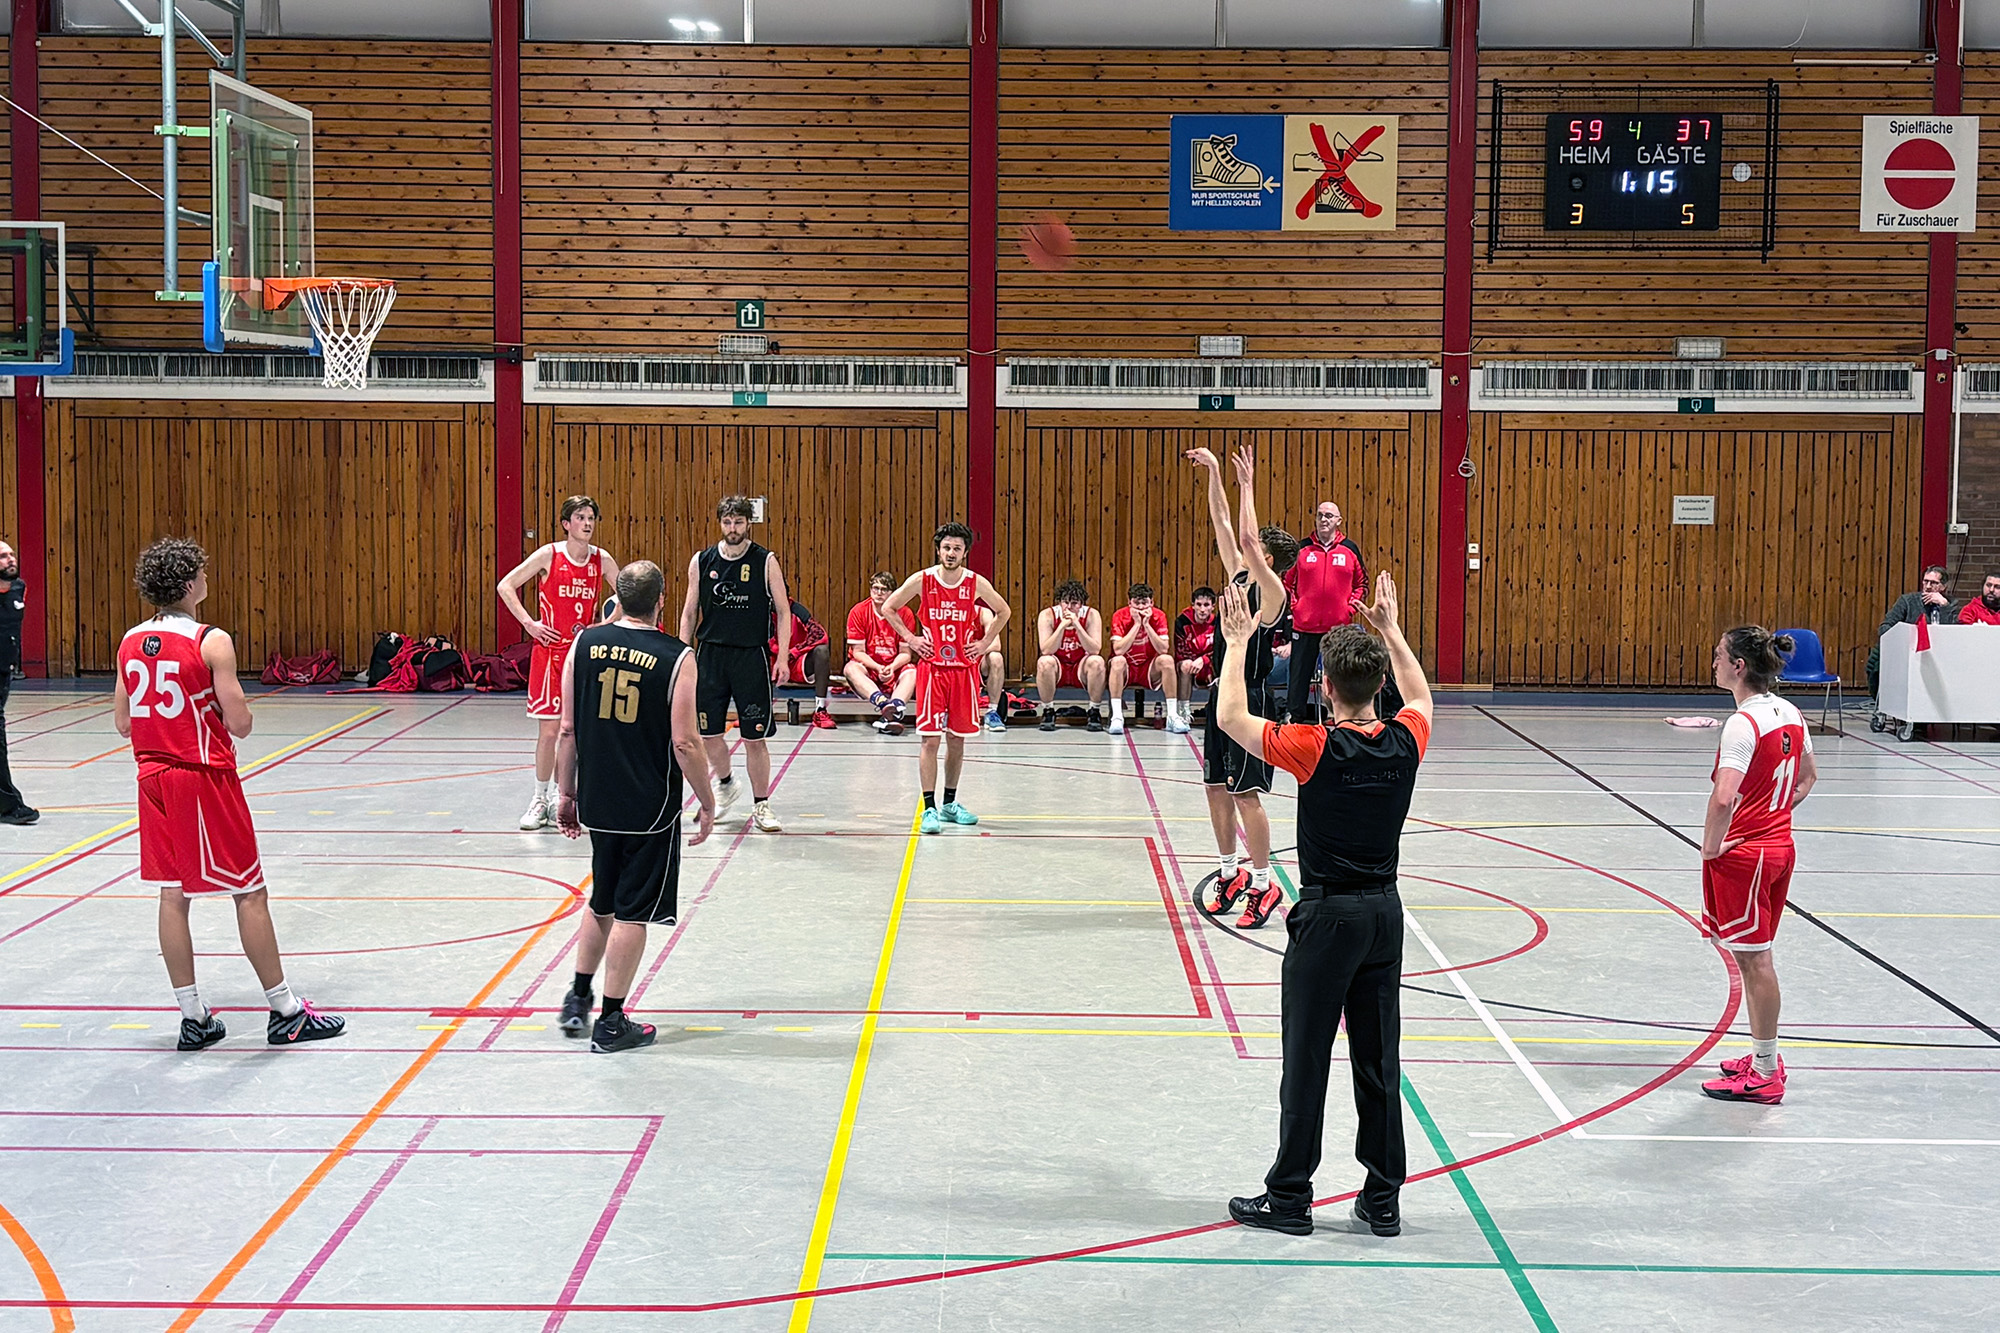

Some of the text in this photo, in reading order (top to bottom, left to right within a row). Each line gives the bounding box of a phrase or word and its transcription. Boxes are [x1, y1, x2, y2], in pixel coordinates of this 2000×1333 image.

[1568, 119, 1604, 141] 59
[1628, 120, 1642, 141] 4
[1676, 119, 1711, 141] 37
[1889, 120, 1954, 136] Spielfläche
[1559, 146, 1611, 164] HEIM
[1637, 143, 1706, 164] GÄSTE
[1620, 170, 1675, 194] 1:15
[1569, 203, 1584, 225] 3
[1681, 203, 1695, 225] 5
[1877, 213, 1959, 227] Für Zuschauer
[572, 577, 587, 586] BBC
[740, 563, 751, 582] 6
[558, 585, 596, 600] EUPEN
[574, 601, 584, 620] 9
[940, 600, 957, 609] BBC
[928, 607, 968, 622] EUPEN
[939, 624, 957, 642] 13
[589, 645, 658, 671] BC ST. VITH
[125, 658, 185, 720] 25
[598, 666, 642, 724] 15
[551, 695, 561, 713] 9
[698, 711, 708, 730] 6
[1768, 755, 1796, 813] 11
